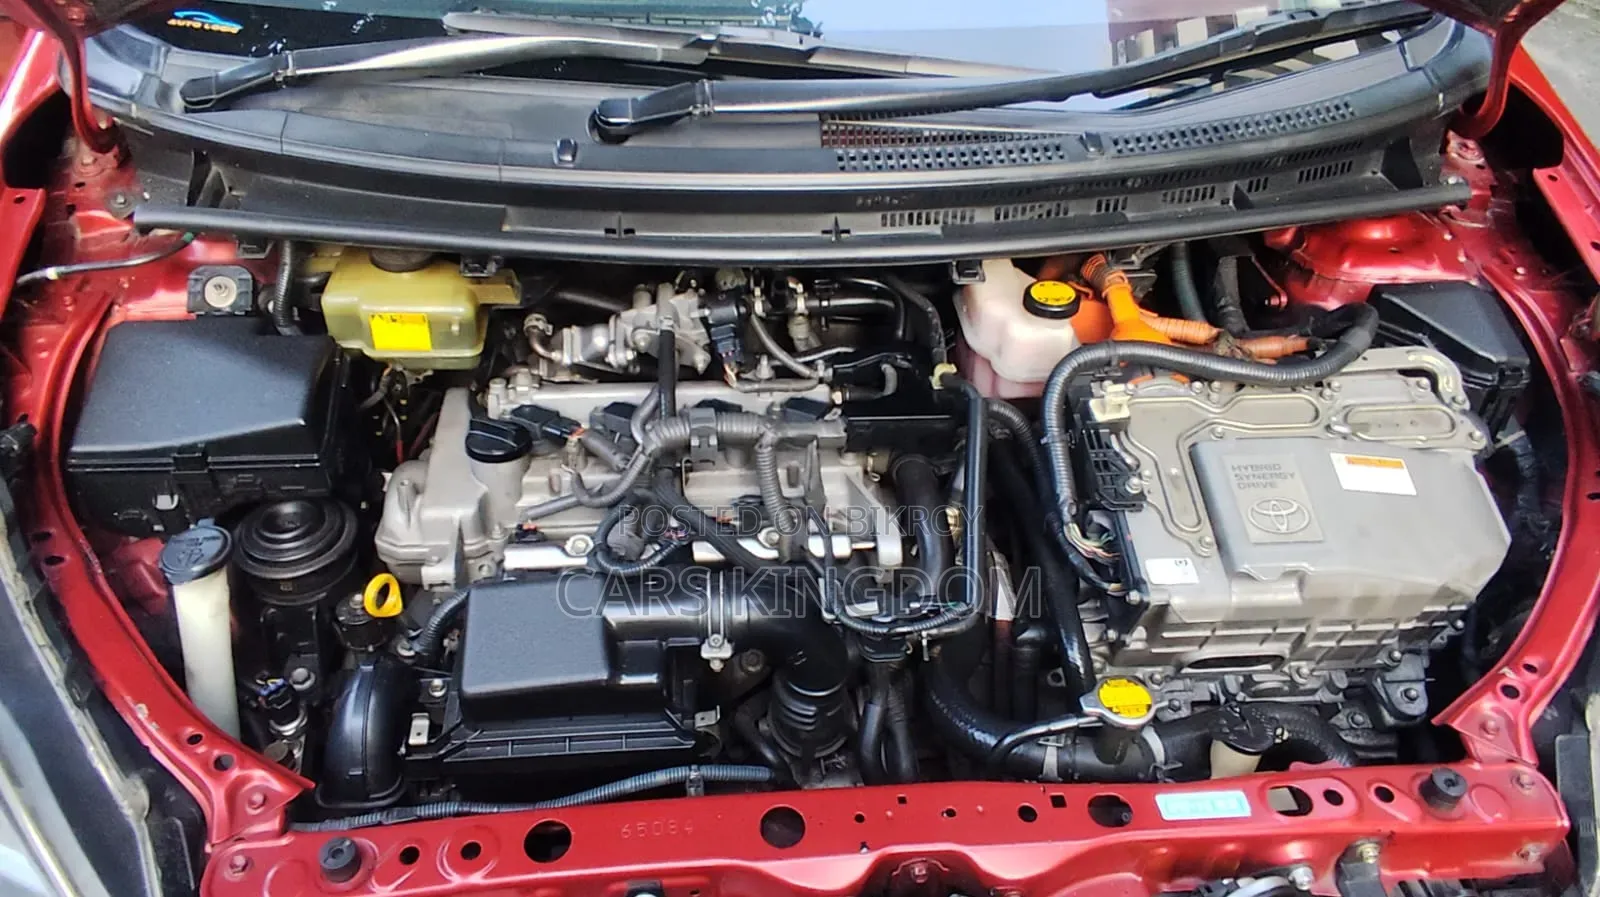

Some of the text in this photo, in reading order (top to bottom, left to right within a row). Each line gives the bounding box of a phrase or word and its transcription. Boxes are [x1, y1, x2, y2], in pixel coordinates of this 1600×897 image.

[166, 18, 203, 29] AUTO
[1231, 463, 1282, 472] HYBRID
[1234, 472, 1295, 481] SYNERGY
[1237, 481, 1278, 490] DRIVE
[621, 819, 693, 839] 65084
